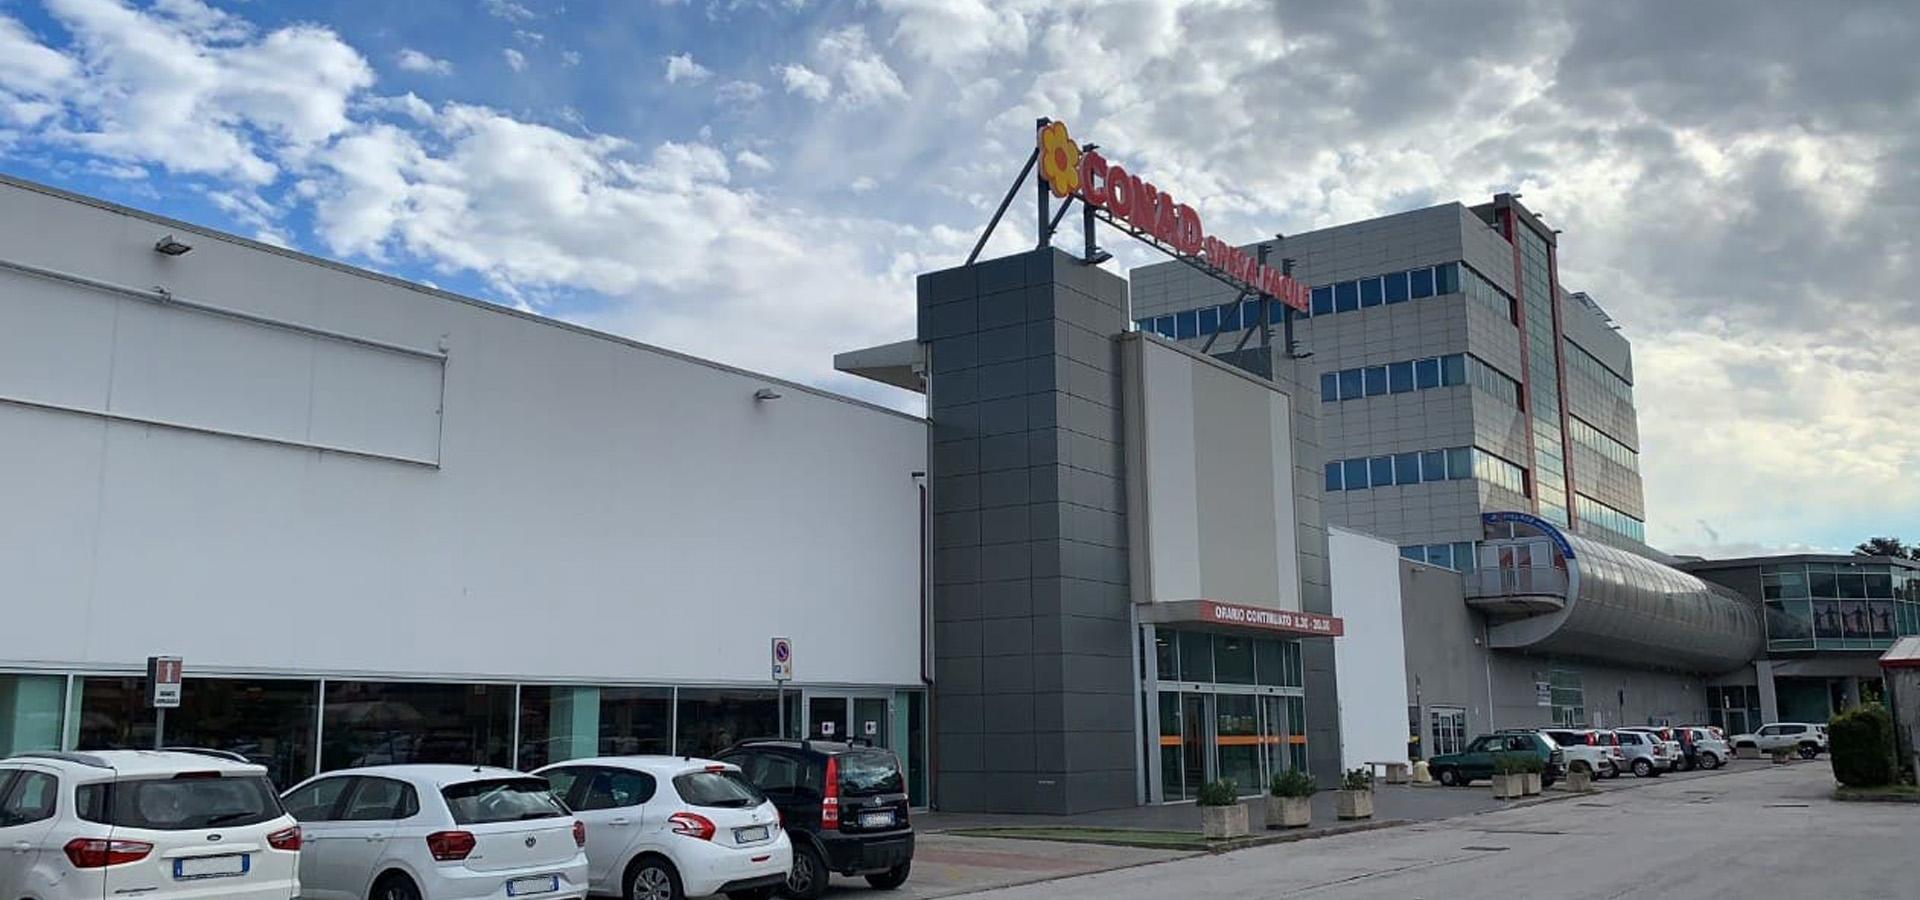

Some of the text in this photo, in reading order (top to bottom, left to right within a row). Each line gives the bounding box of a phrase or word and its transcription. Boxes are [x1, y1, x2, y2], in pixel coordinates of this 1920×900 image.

[1080, 151, 1203, 256] CONAD
[1204, 235, 1259, 290] SPESA
[1215, 605, 1245, 621] ORARIO
[1246, 609, 1292, 627] CONTINUATO
